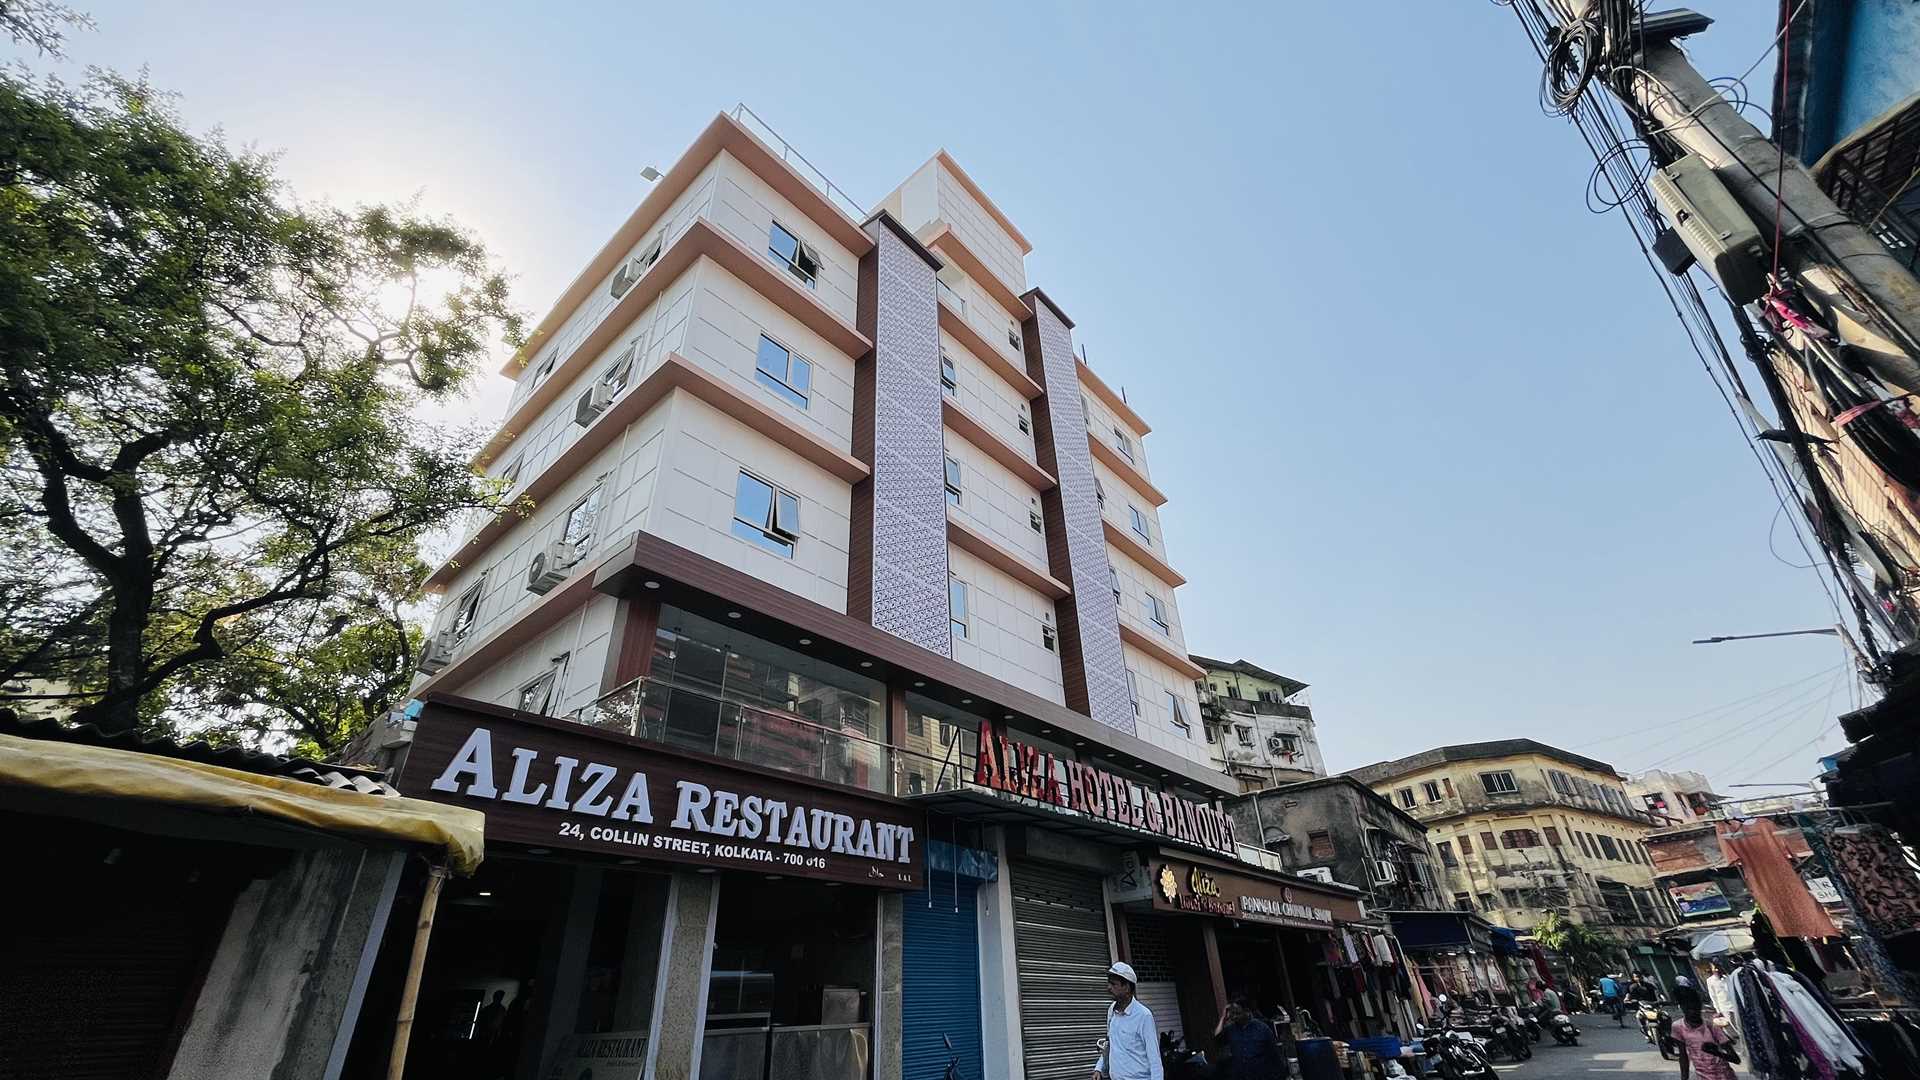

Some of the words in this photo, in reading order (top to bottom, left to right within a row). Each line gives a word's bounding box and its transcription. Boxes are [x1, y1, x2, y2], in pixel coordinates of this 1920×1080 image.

[430, 727, 654, 824] ALIZA
[671, 780, 914, 864] RESTAURANT
[1066, 759, 1144, 827] HOTEL
[1144, 785, 1164, 833] &
[1160, 791, 1239, 853] BANQUET
[559, 822, 584, 841] 24,
[590, 828, 648, 849] COLLIN
[653, 834, 710, 856] STREET,
[714, 844, 772, 863] KOLKATA
[783, 852, 804, 866] 700
